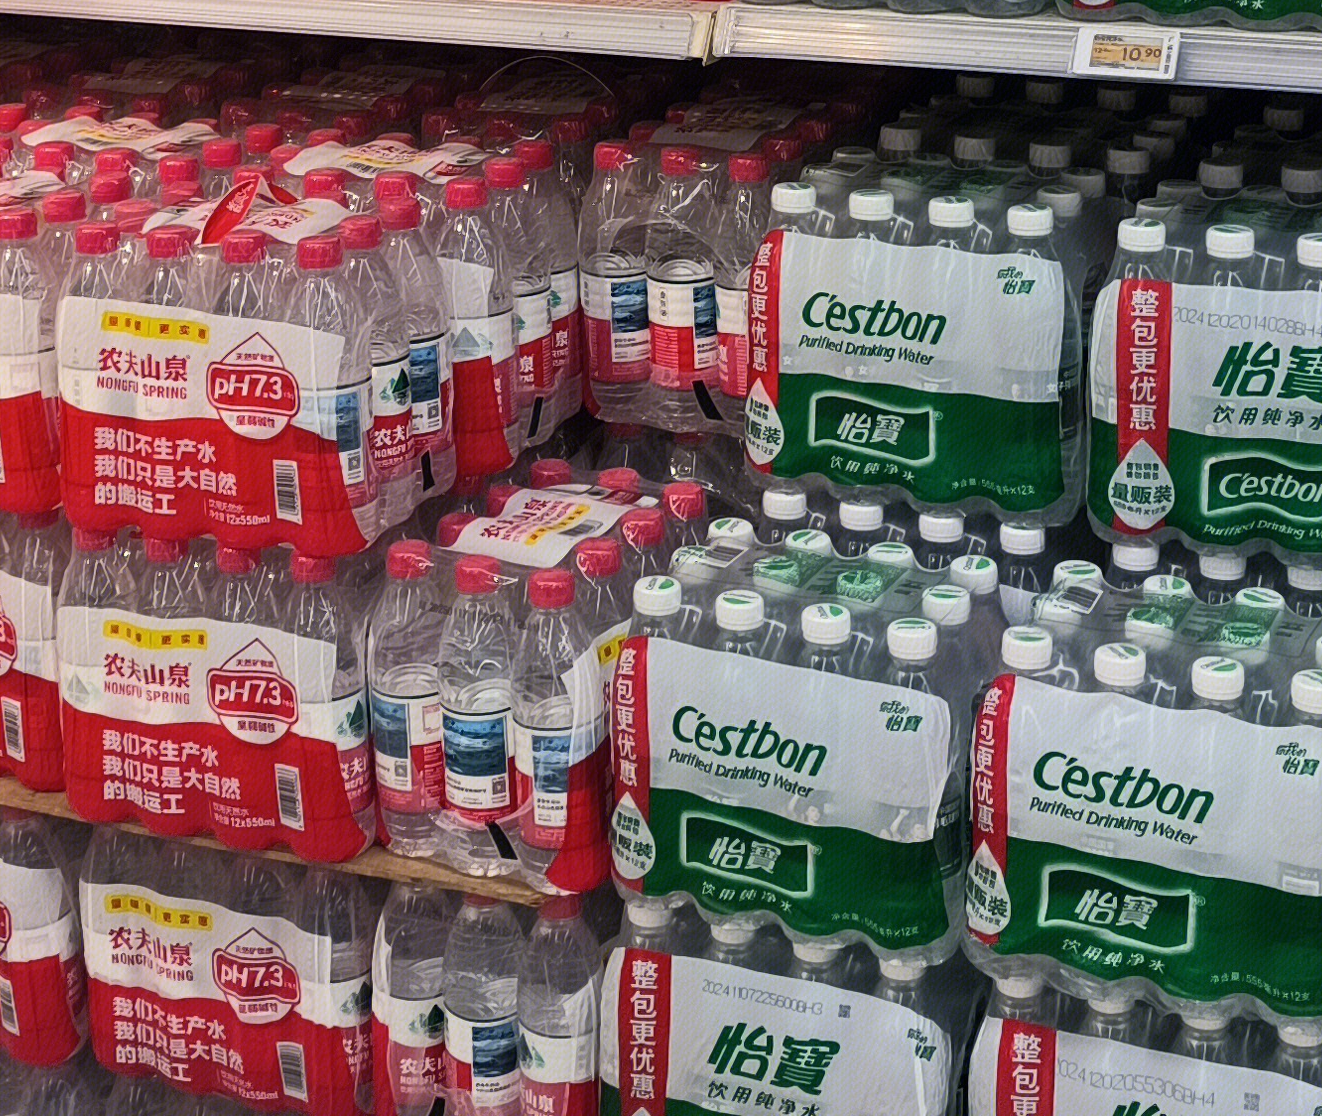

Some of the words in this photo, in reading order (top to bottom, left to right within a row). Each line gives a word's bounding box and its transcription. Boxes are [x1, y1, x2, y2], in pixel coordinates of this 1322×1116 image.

[1122, 47, 1162, 62] 10.90
[99, 348, 188, 382] 农夫山泉
[1130, 289, 1159, 429] 整包更优惠
[97, 376, 139, 393] NONGFU
[143, 386, 187, 399] SPRING
[215, 374, 281, 400] pH7.3
[94, 427, 216, 463] 我们不生产水
[94, 455, 237, 496] 我们只是大自然
[104, 654, 191, 687] 农夫山泉
[146, 688, 190, 704] SPRING
[214, 679, 283, 703] pH7.3
[103, 730, 219, 768] 我们不生产水
[103, 756, 240, 799] 我们只是大自然
[1030, 796, 1085, 823] Purified
[1086, 809, 1148, 840] Drinking
[1150, 823, 1198, 845] Water
[708, 836, 782, 873] 怡寶
[109, 927, 193, 967] 农夫山泉
[220, 964, 283, 987] pH7.3
[113, 997, 226, 1041] 我们不生产水
[630, 959, 657, 1098] 整包更优惠
[114, 1022, 244, 1074] 我们只是大自然
